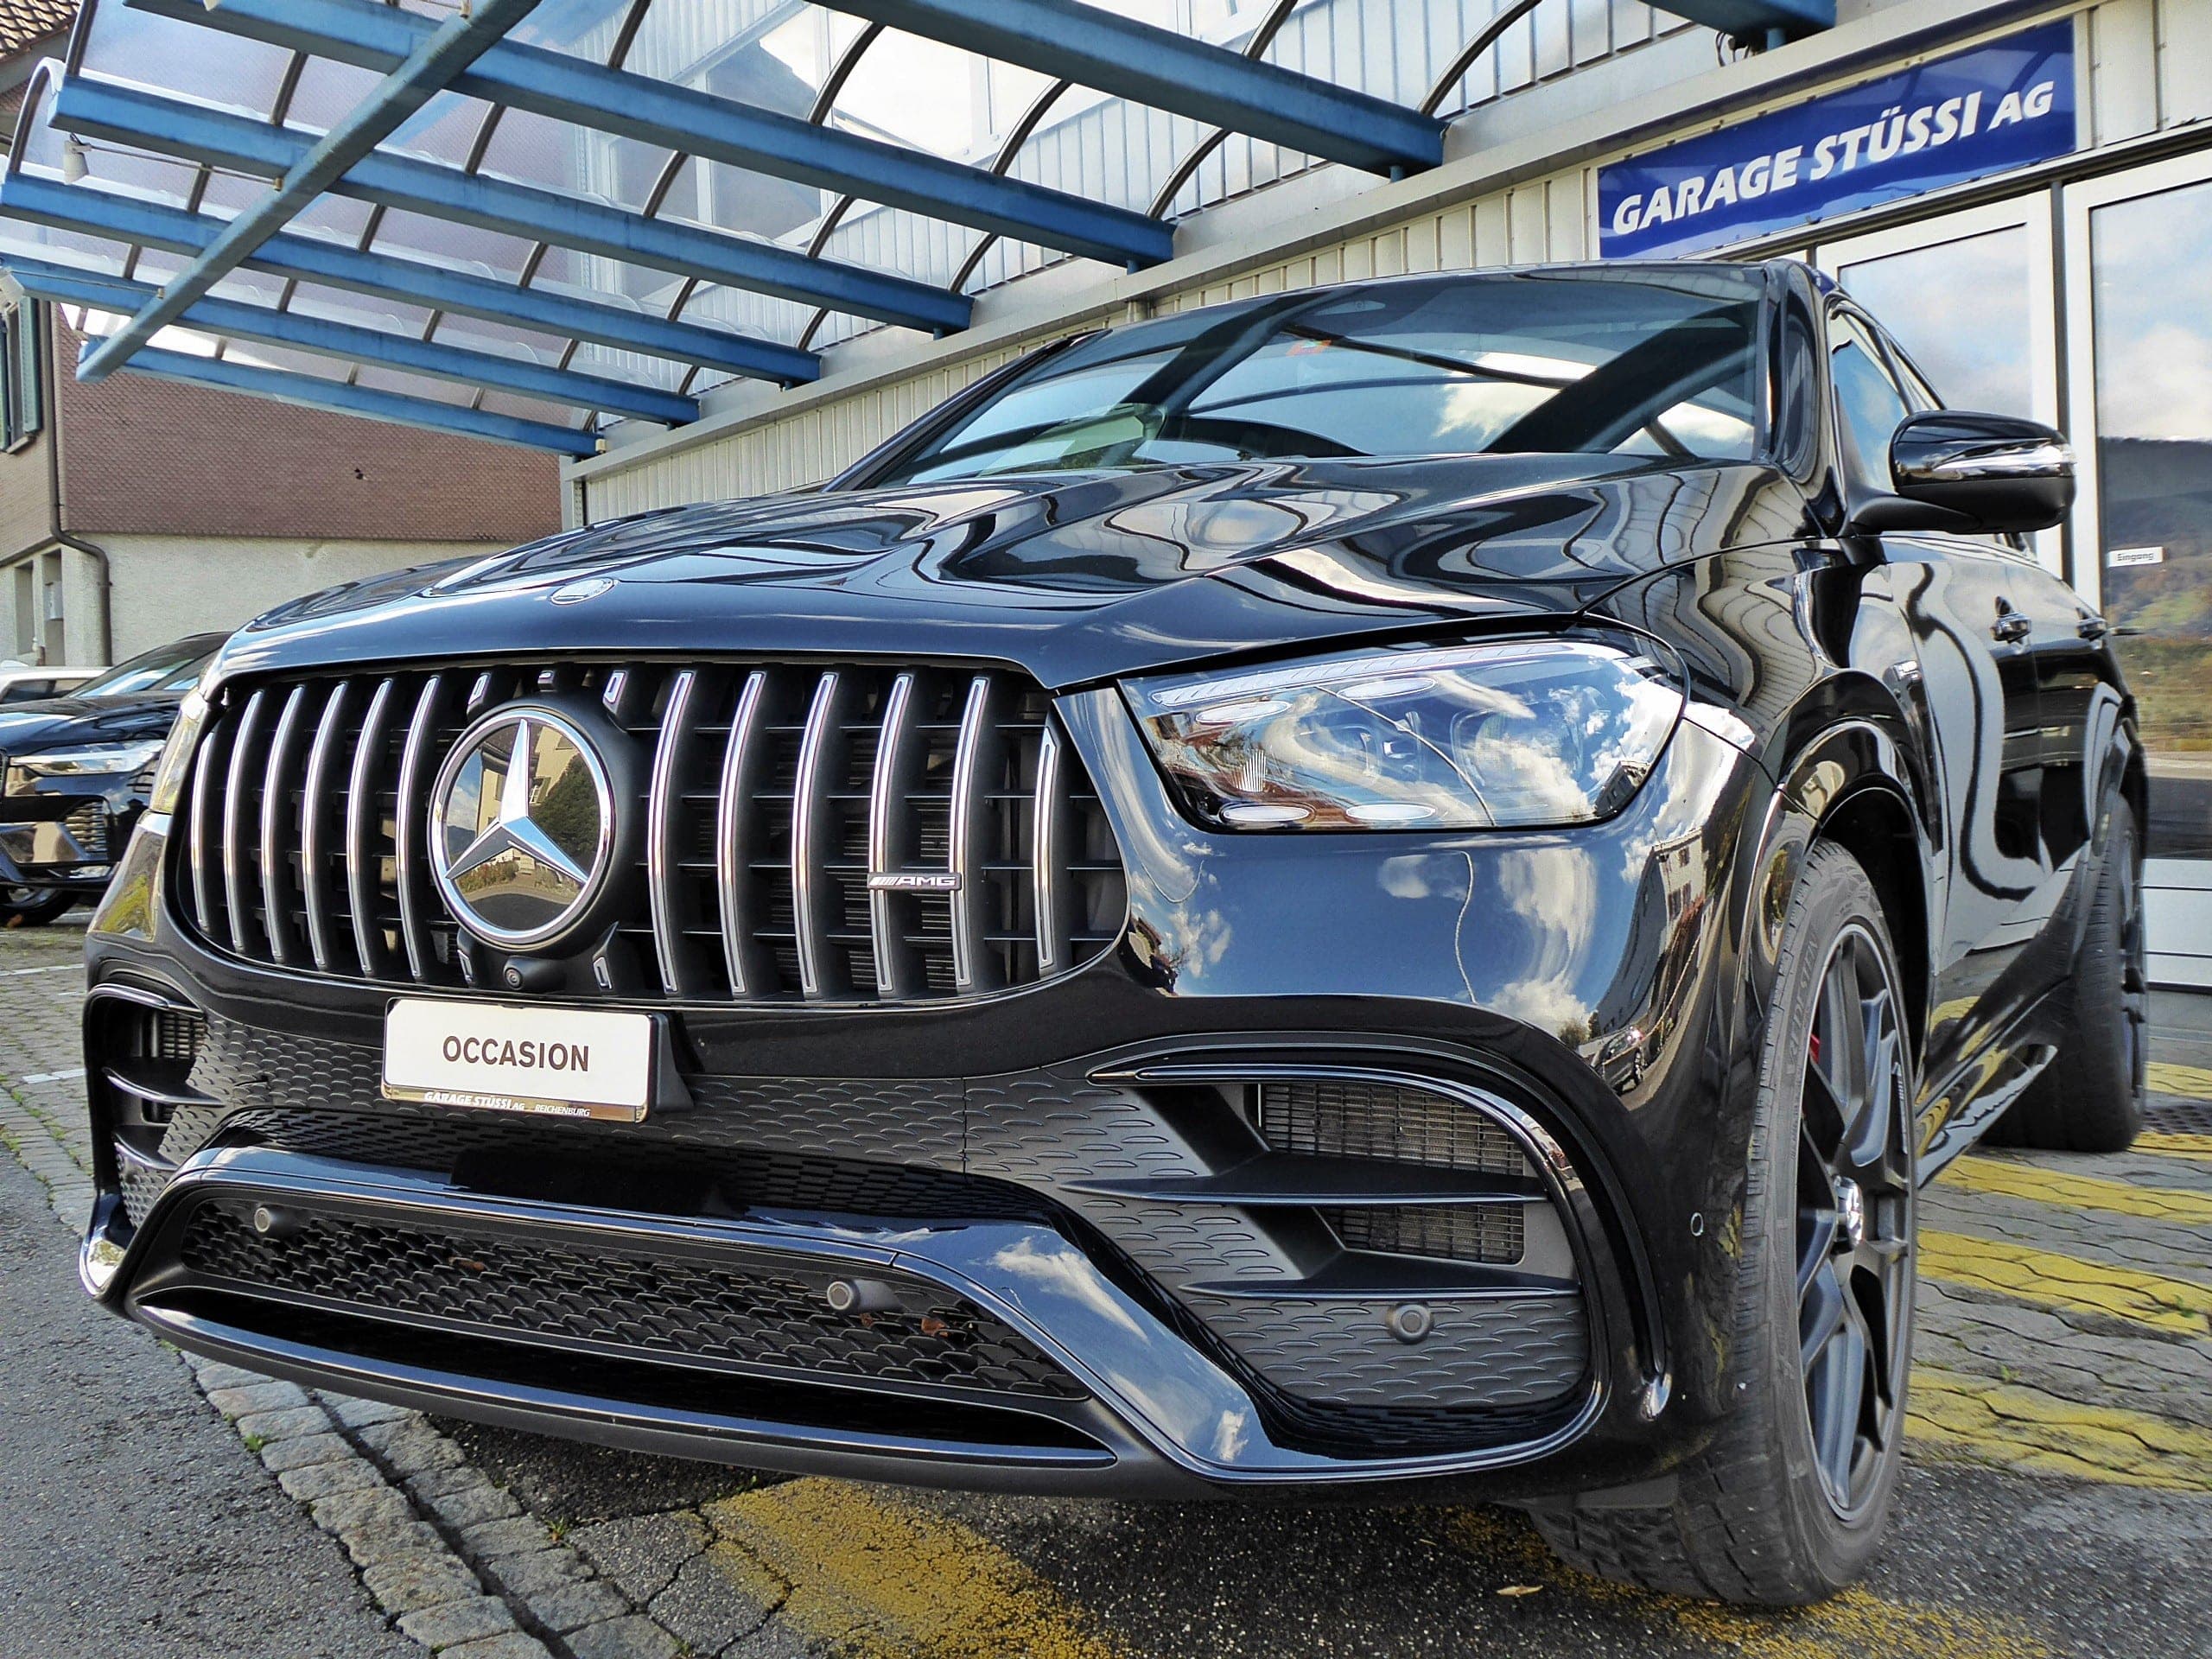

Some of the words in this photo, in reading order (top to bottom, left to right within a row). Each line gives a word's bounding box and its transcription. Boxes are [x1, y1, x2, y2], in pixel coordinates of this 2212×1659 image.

[1613, 147, 1803, 236] GARAGE
[1809, 91, 1981, 182] STÜSSI
[1986, 81, 2054, 132] AG
[895, 875, 956, 887] AMG
[442, 1035, 589, 1072] OCCASION
[423, 1090, 473, 1107] GARAGE
[474, 1093, 512, 1110] STÜSSI
[512, 1102, 525, 1112] AG
[534, 1103, 591, 1117] REICHENBURG
